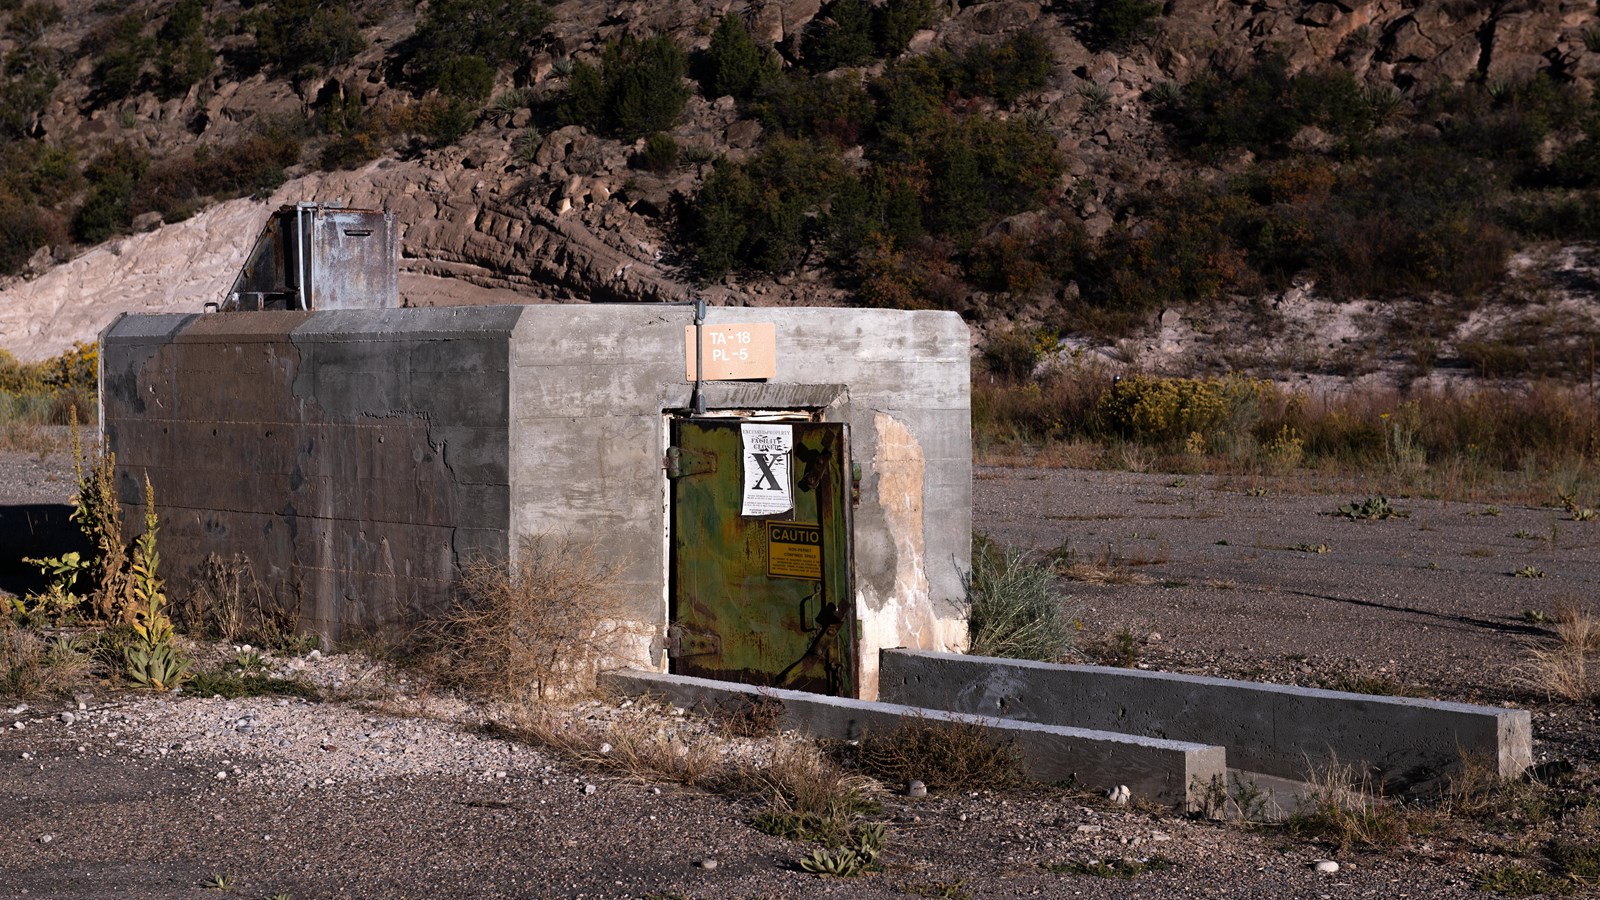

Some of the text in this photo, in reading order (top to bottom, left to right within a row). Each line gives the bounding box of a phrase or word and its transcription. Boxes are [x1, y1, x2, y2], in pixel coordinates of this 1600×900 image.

[709, 331, 751, 345] TA-18
[712, 348, 748, 361] PL-5
[751, 453, 783, 490] X
[772, 528, 819, 543] CAUTIO
